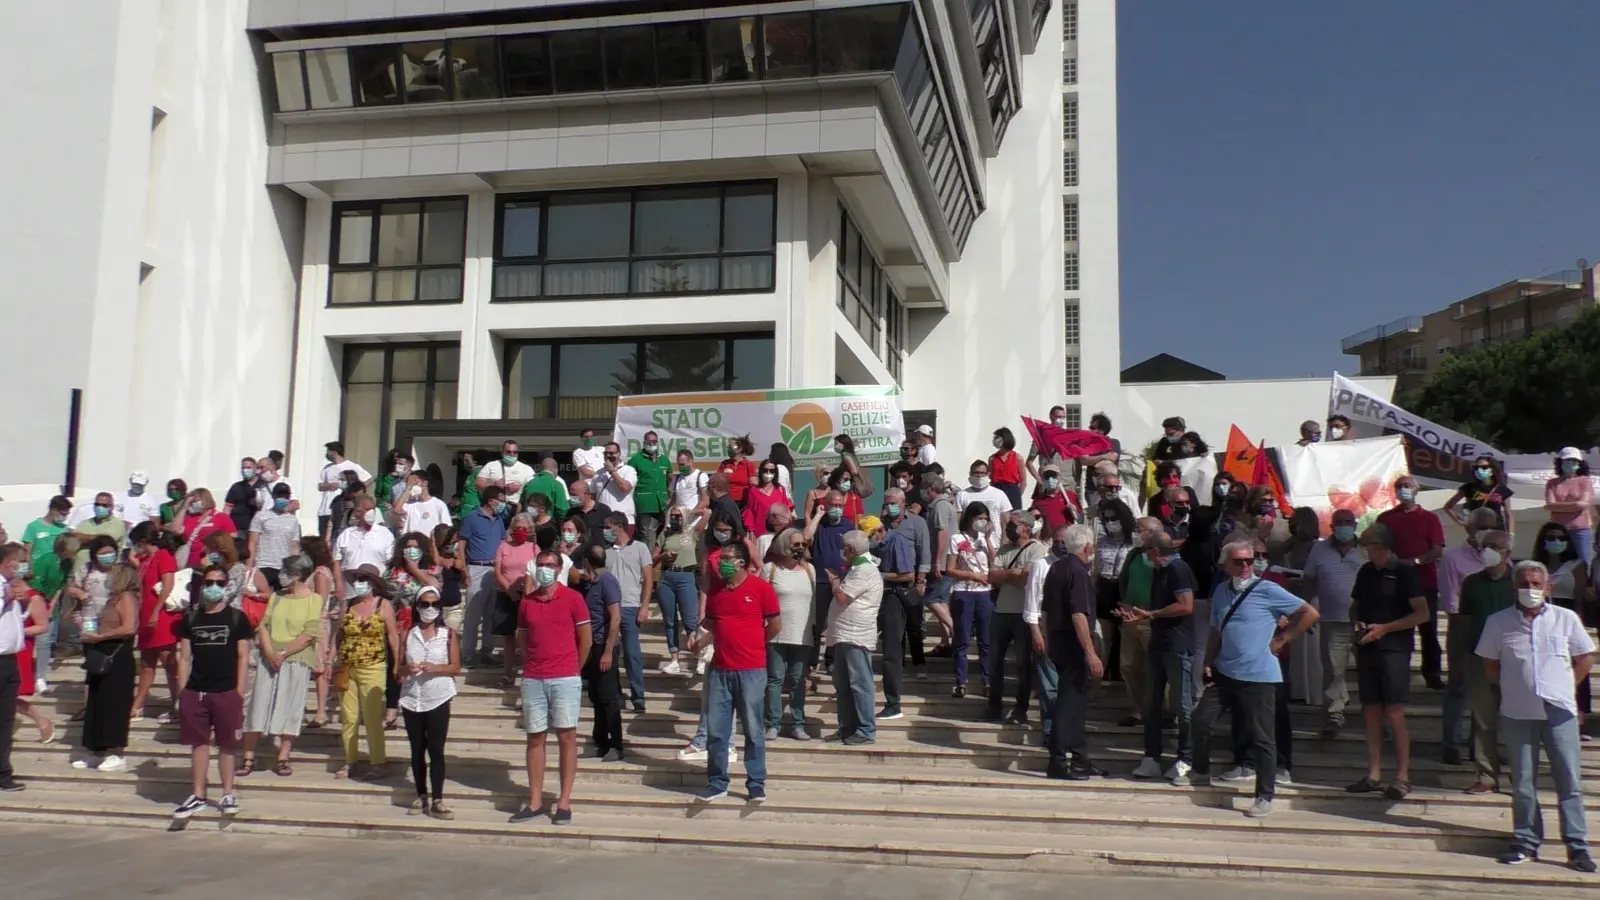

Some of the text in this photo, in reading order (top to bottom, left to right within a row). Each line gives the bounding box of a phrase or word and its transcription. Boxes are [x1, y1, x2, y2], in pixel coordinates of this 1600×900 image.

[651, 407, 722, 429] STATO
[842, 412, 892, 426] DELIZIE
[842, 427, 874, 437] DELLA
[626, 437, 688, 458] DVE
[853, 436, 894, 449] ATURA
